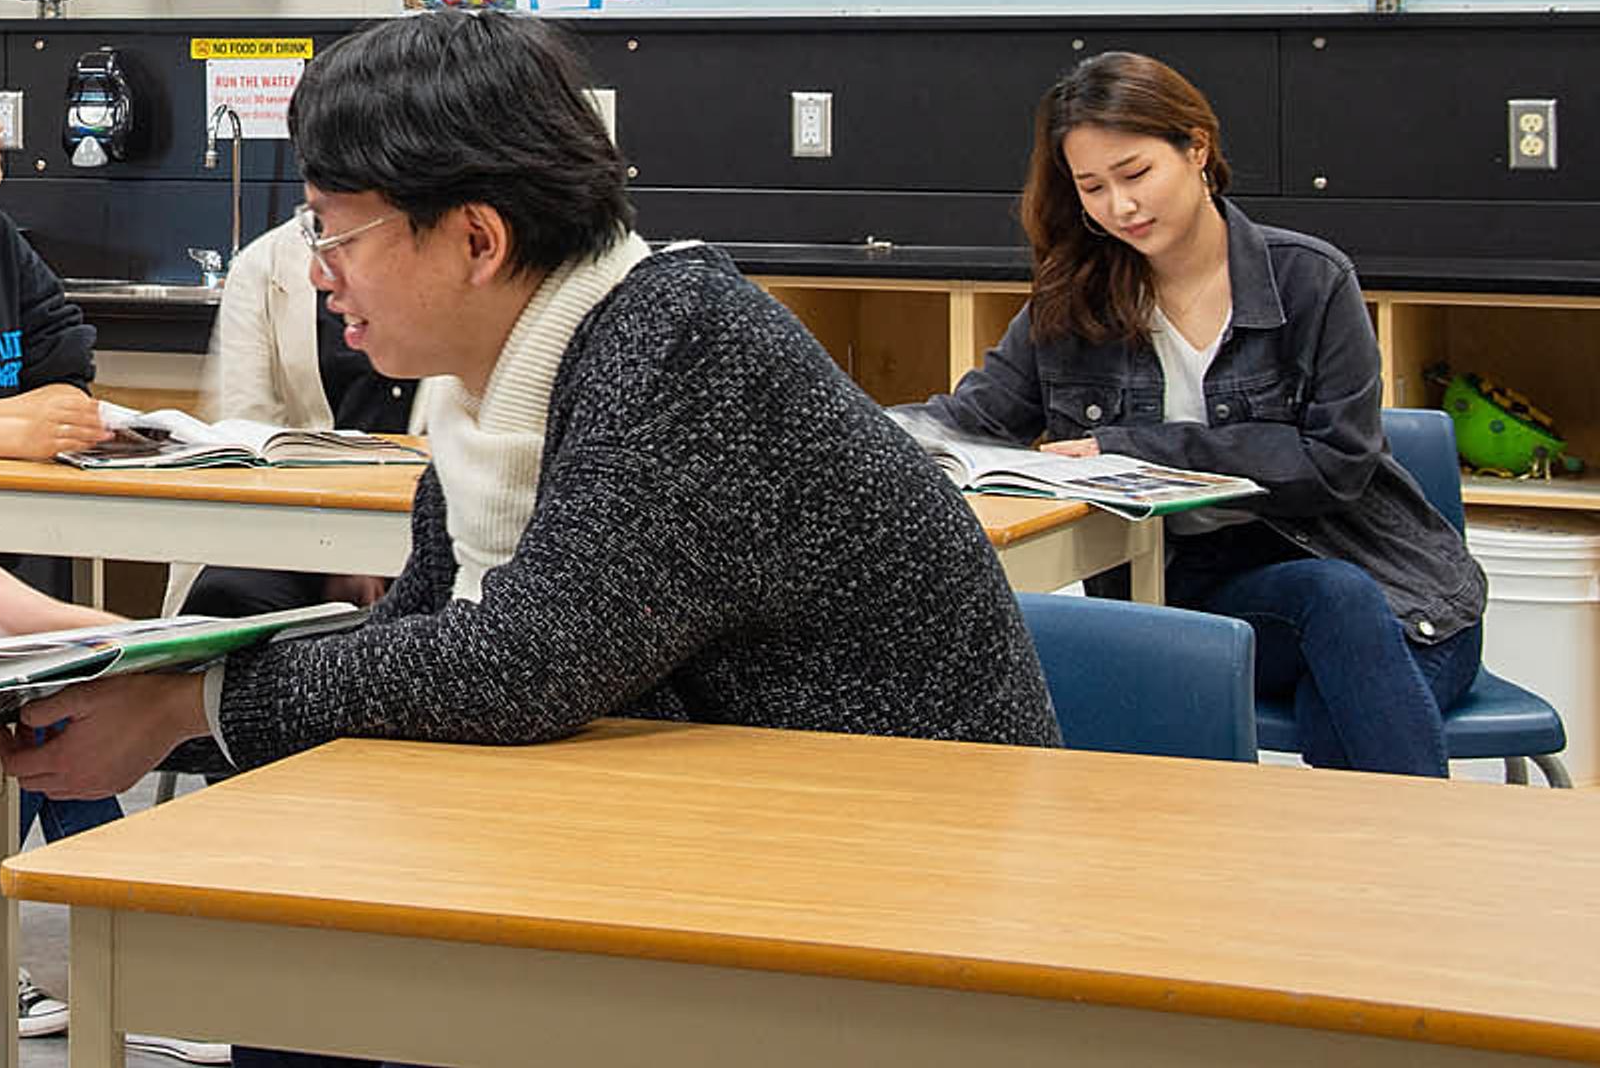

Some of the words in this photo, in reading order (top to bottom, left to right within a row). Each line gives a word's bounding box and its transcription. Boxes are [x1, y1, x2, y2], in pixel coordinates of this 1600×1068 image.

[213, 42, 228, 53] NO
[230, 42, 257, 53] FOOD
[259, 42, 273, 53] OR
[276, 42, 307, 53] DRINK
[215, 76, 237, 88] RUN
[240, 76, 258, 88] THE
[262, 75, 296, 88] WATER
